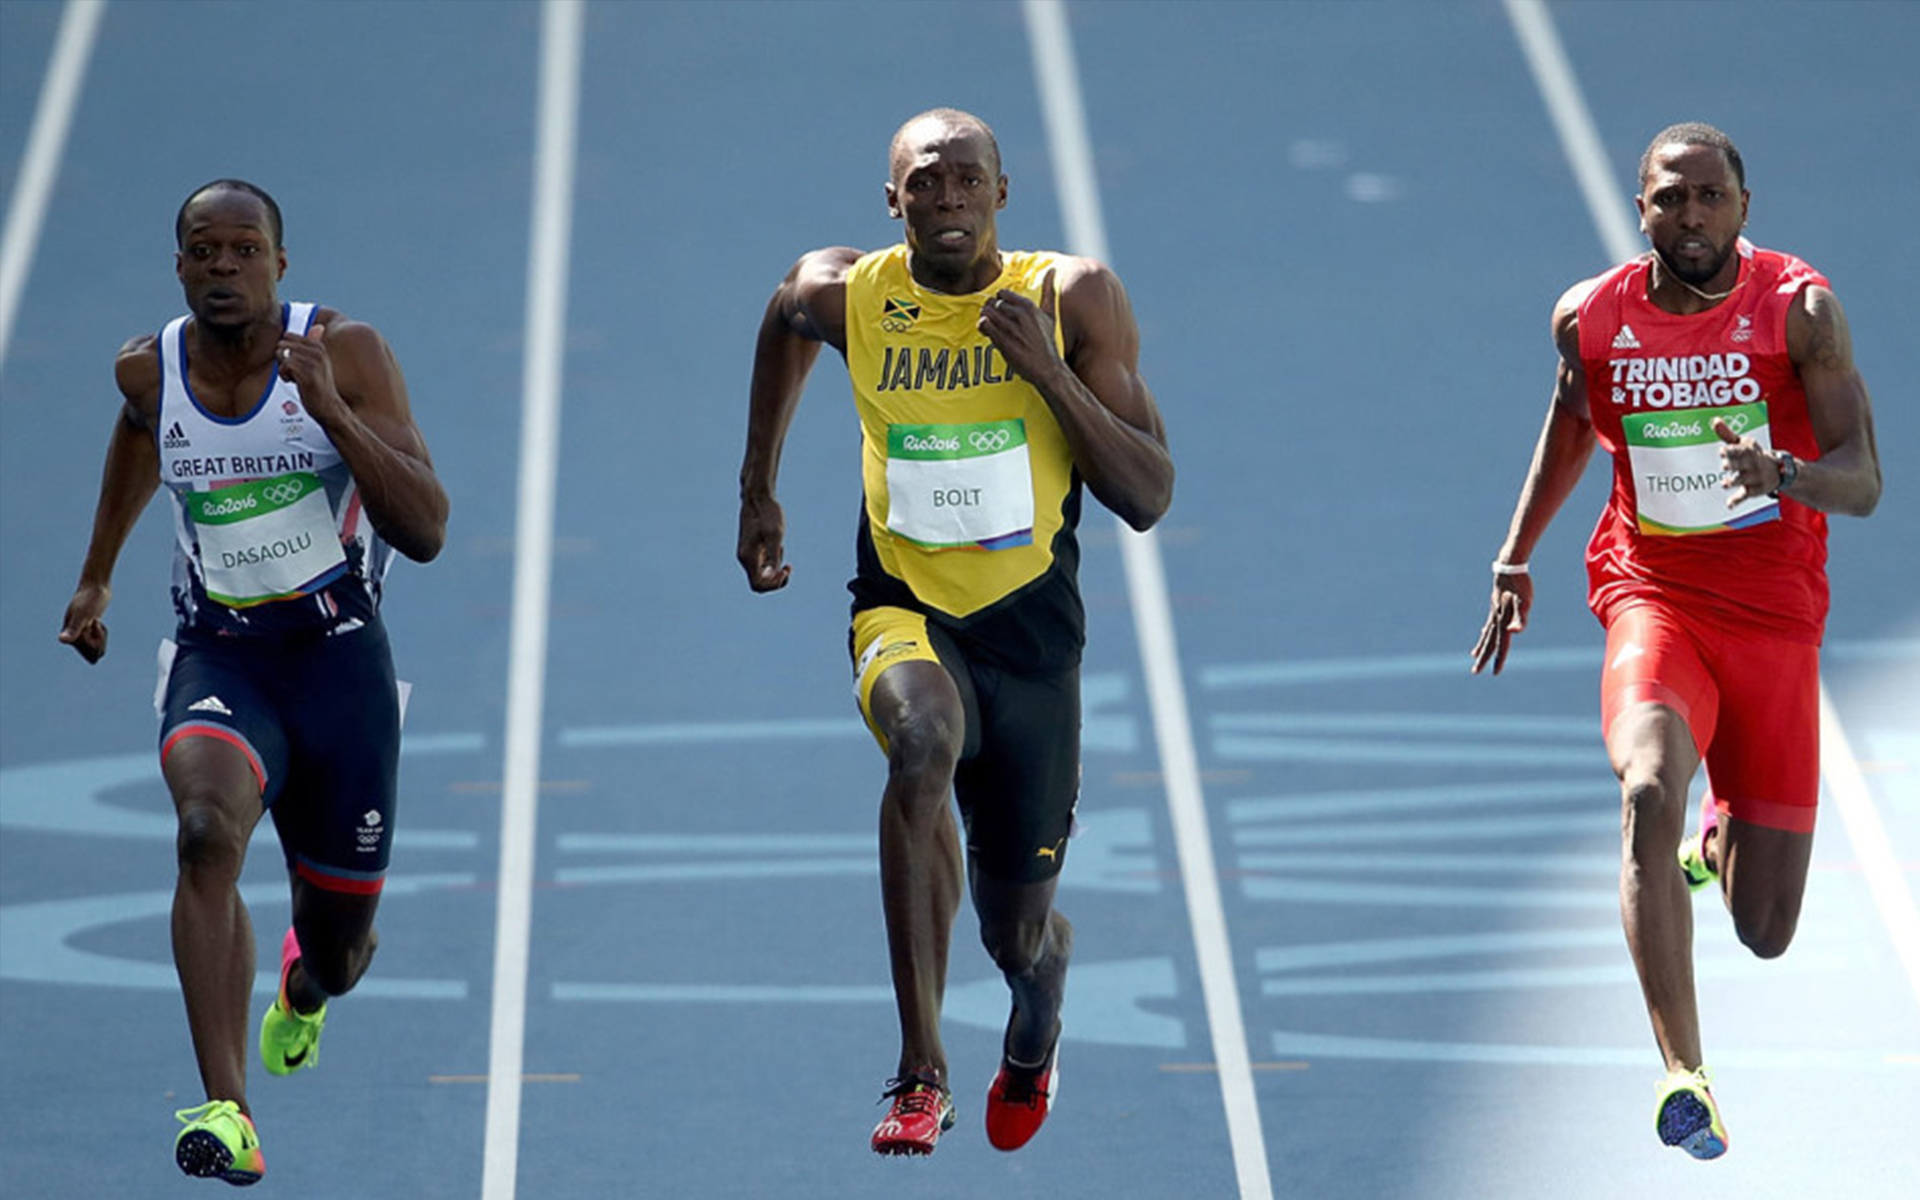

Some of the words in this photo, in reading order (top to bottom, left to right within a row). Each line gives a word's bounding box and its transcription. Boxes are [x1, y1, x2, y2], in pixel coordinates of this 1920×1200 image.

[1609, 353, 1750, 383] TRINIDAD
[163, 439, 191, 449] adidas
[172, 457, 226, 477] GREAT
[232, 452, 314, 474] BRITAIN
[933, 488, 982, 508] BOLT
[221, 532, 312, 569] DASAOLU
